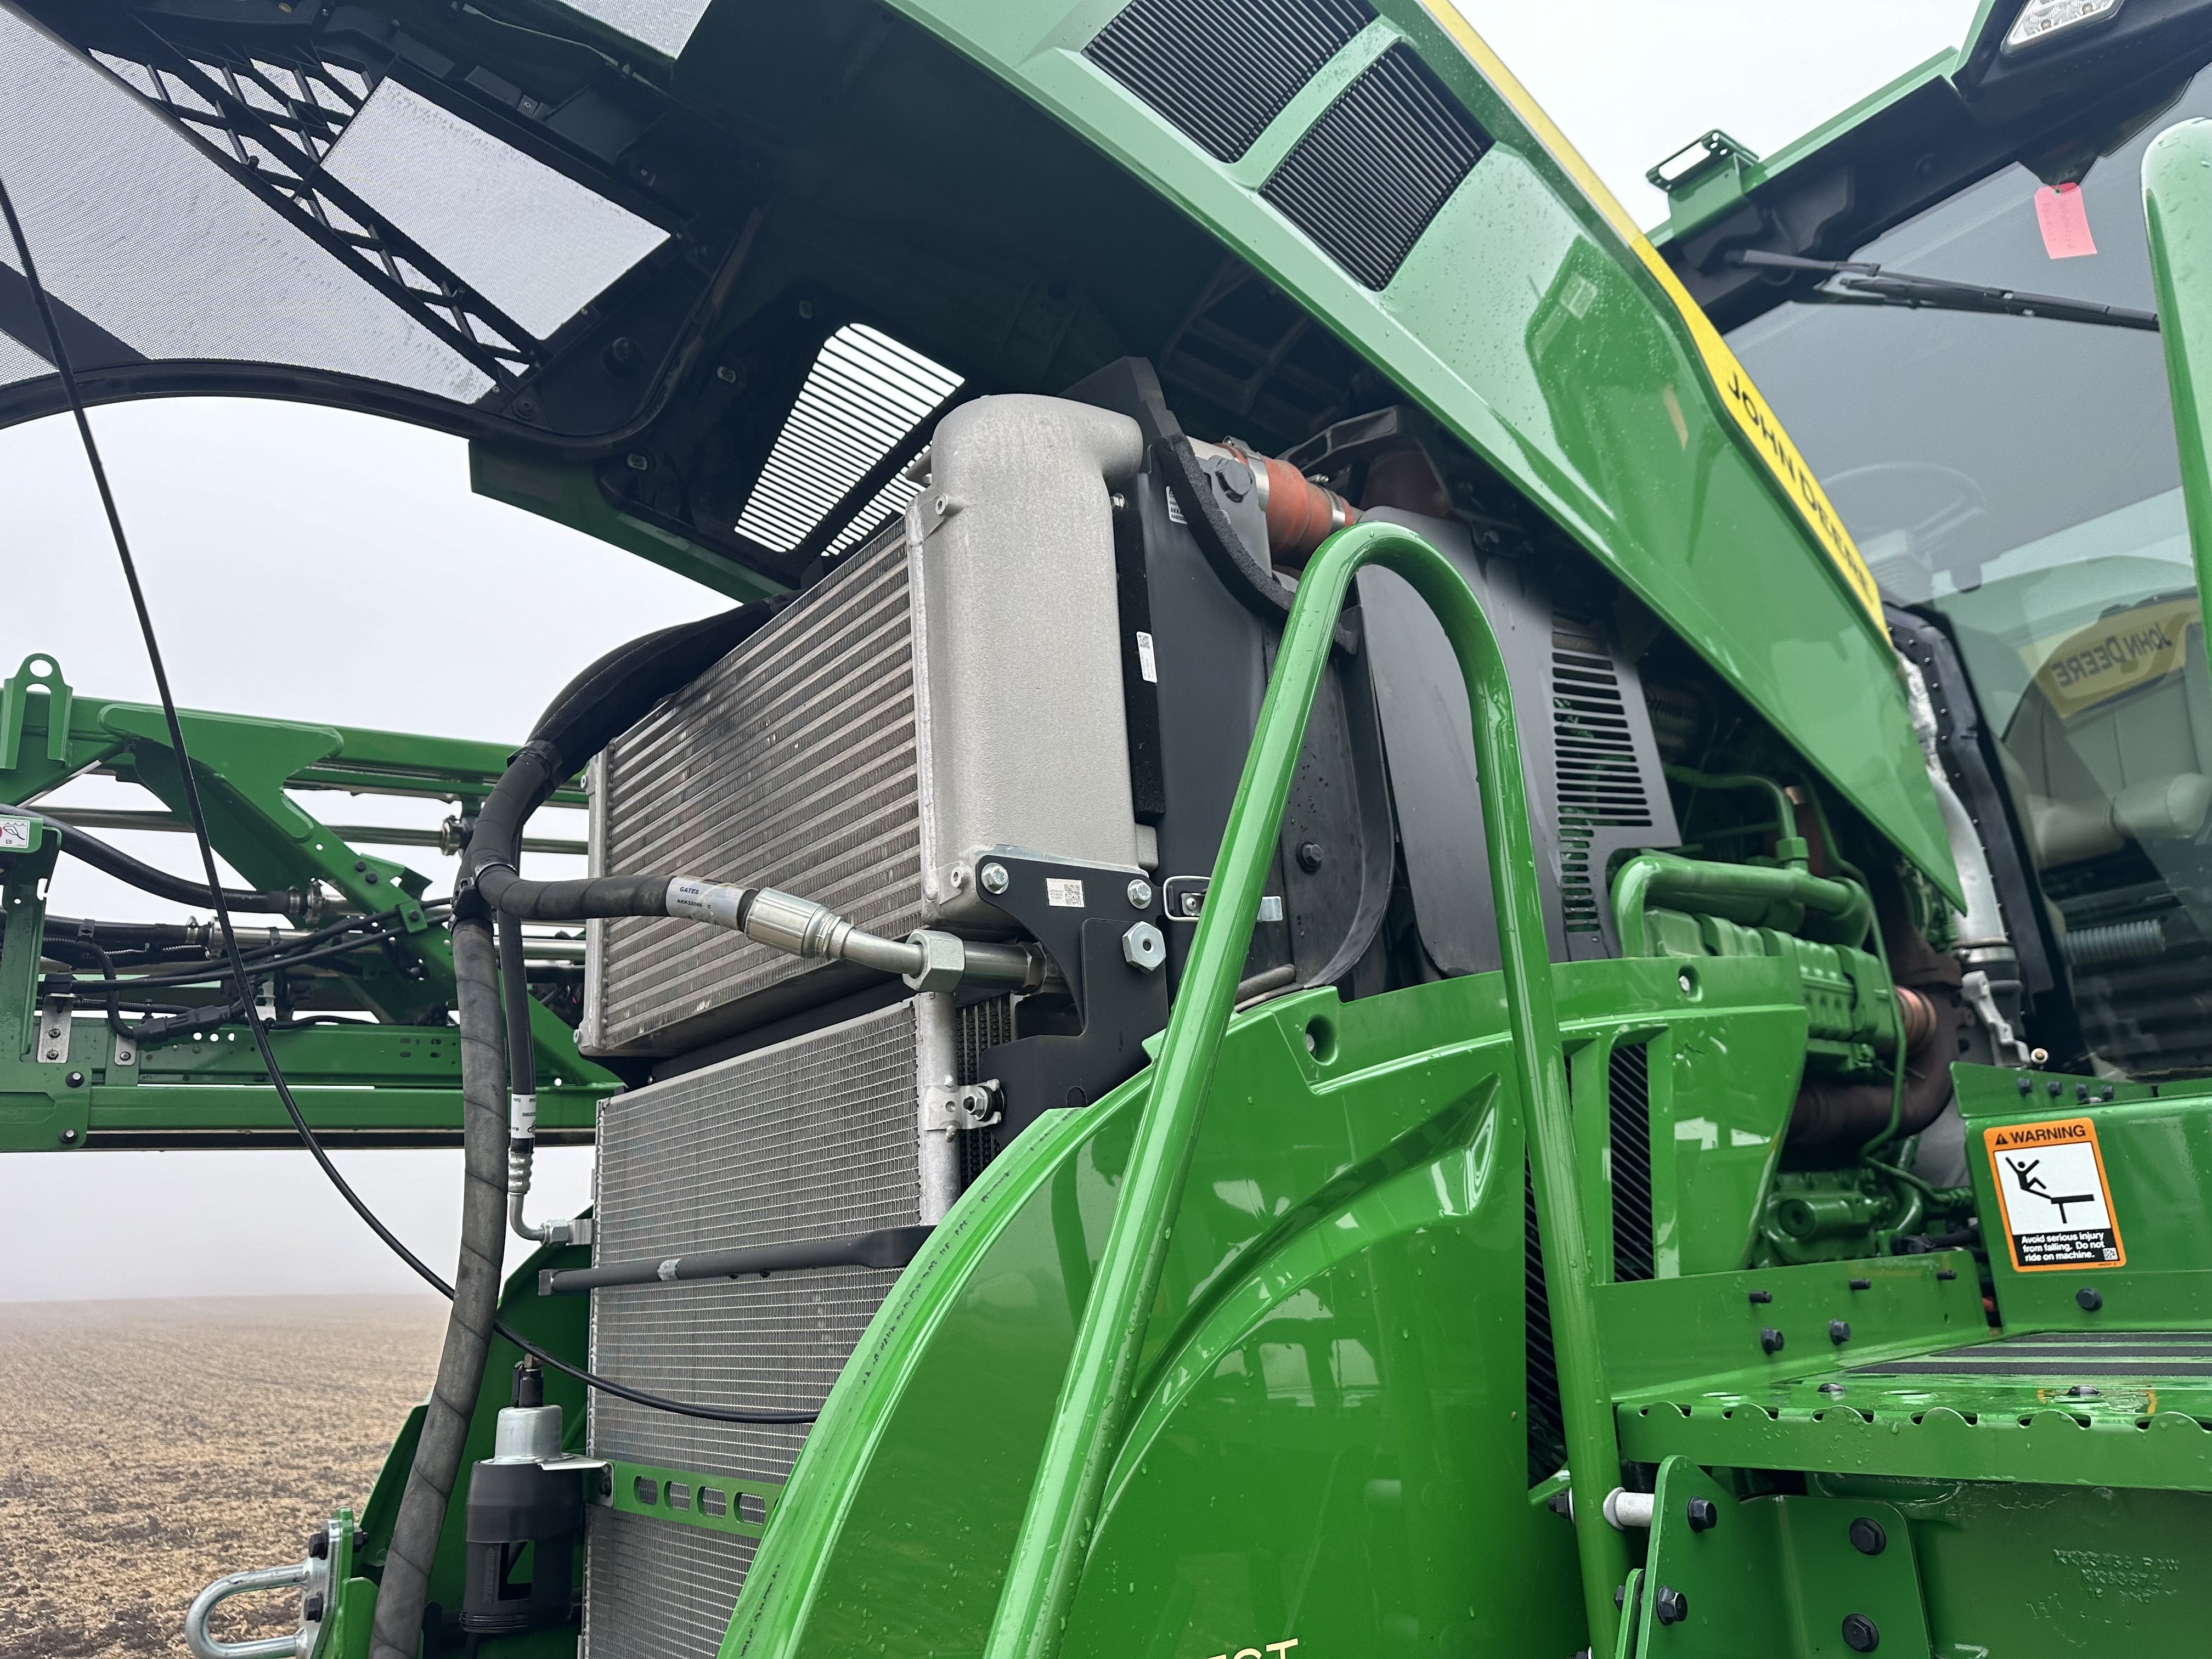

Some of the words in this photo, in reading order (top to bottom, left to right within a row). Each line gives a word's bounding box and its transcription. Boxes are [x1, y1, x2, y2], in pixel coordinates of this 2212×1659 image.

[1728, 371, 1796, 483] JOHN
[1798, 469, 1874, 605] DEERE
[680, 887, 699, 895] GATES
[2010, 1125, 2085, 1143] WARNING
[2021, 1234, 2046, 1244] Avoid
[2046, 1233, 2078, 1242] serious
[2079, 1231, 2104, 1242] injury
[2022, 1245, 2043, 1253] from
[2044, 1243, 2073, 1252] falling.
[2075, 1241, 2089, 1250] Do
[2090, 1240, 2106, 1249] not
[2025, 1253, 2042, 1262] ride
[2056, 1250, 2095, 1260] machine.
